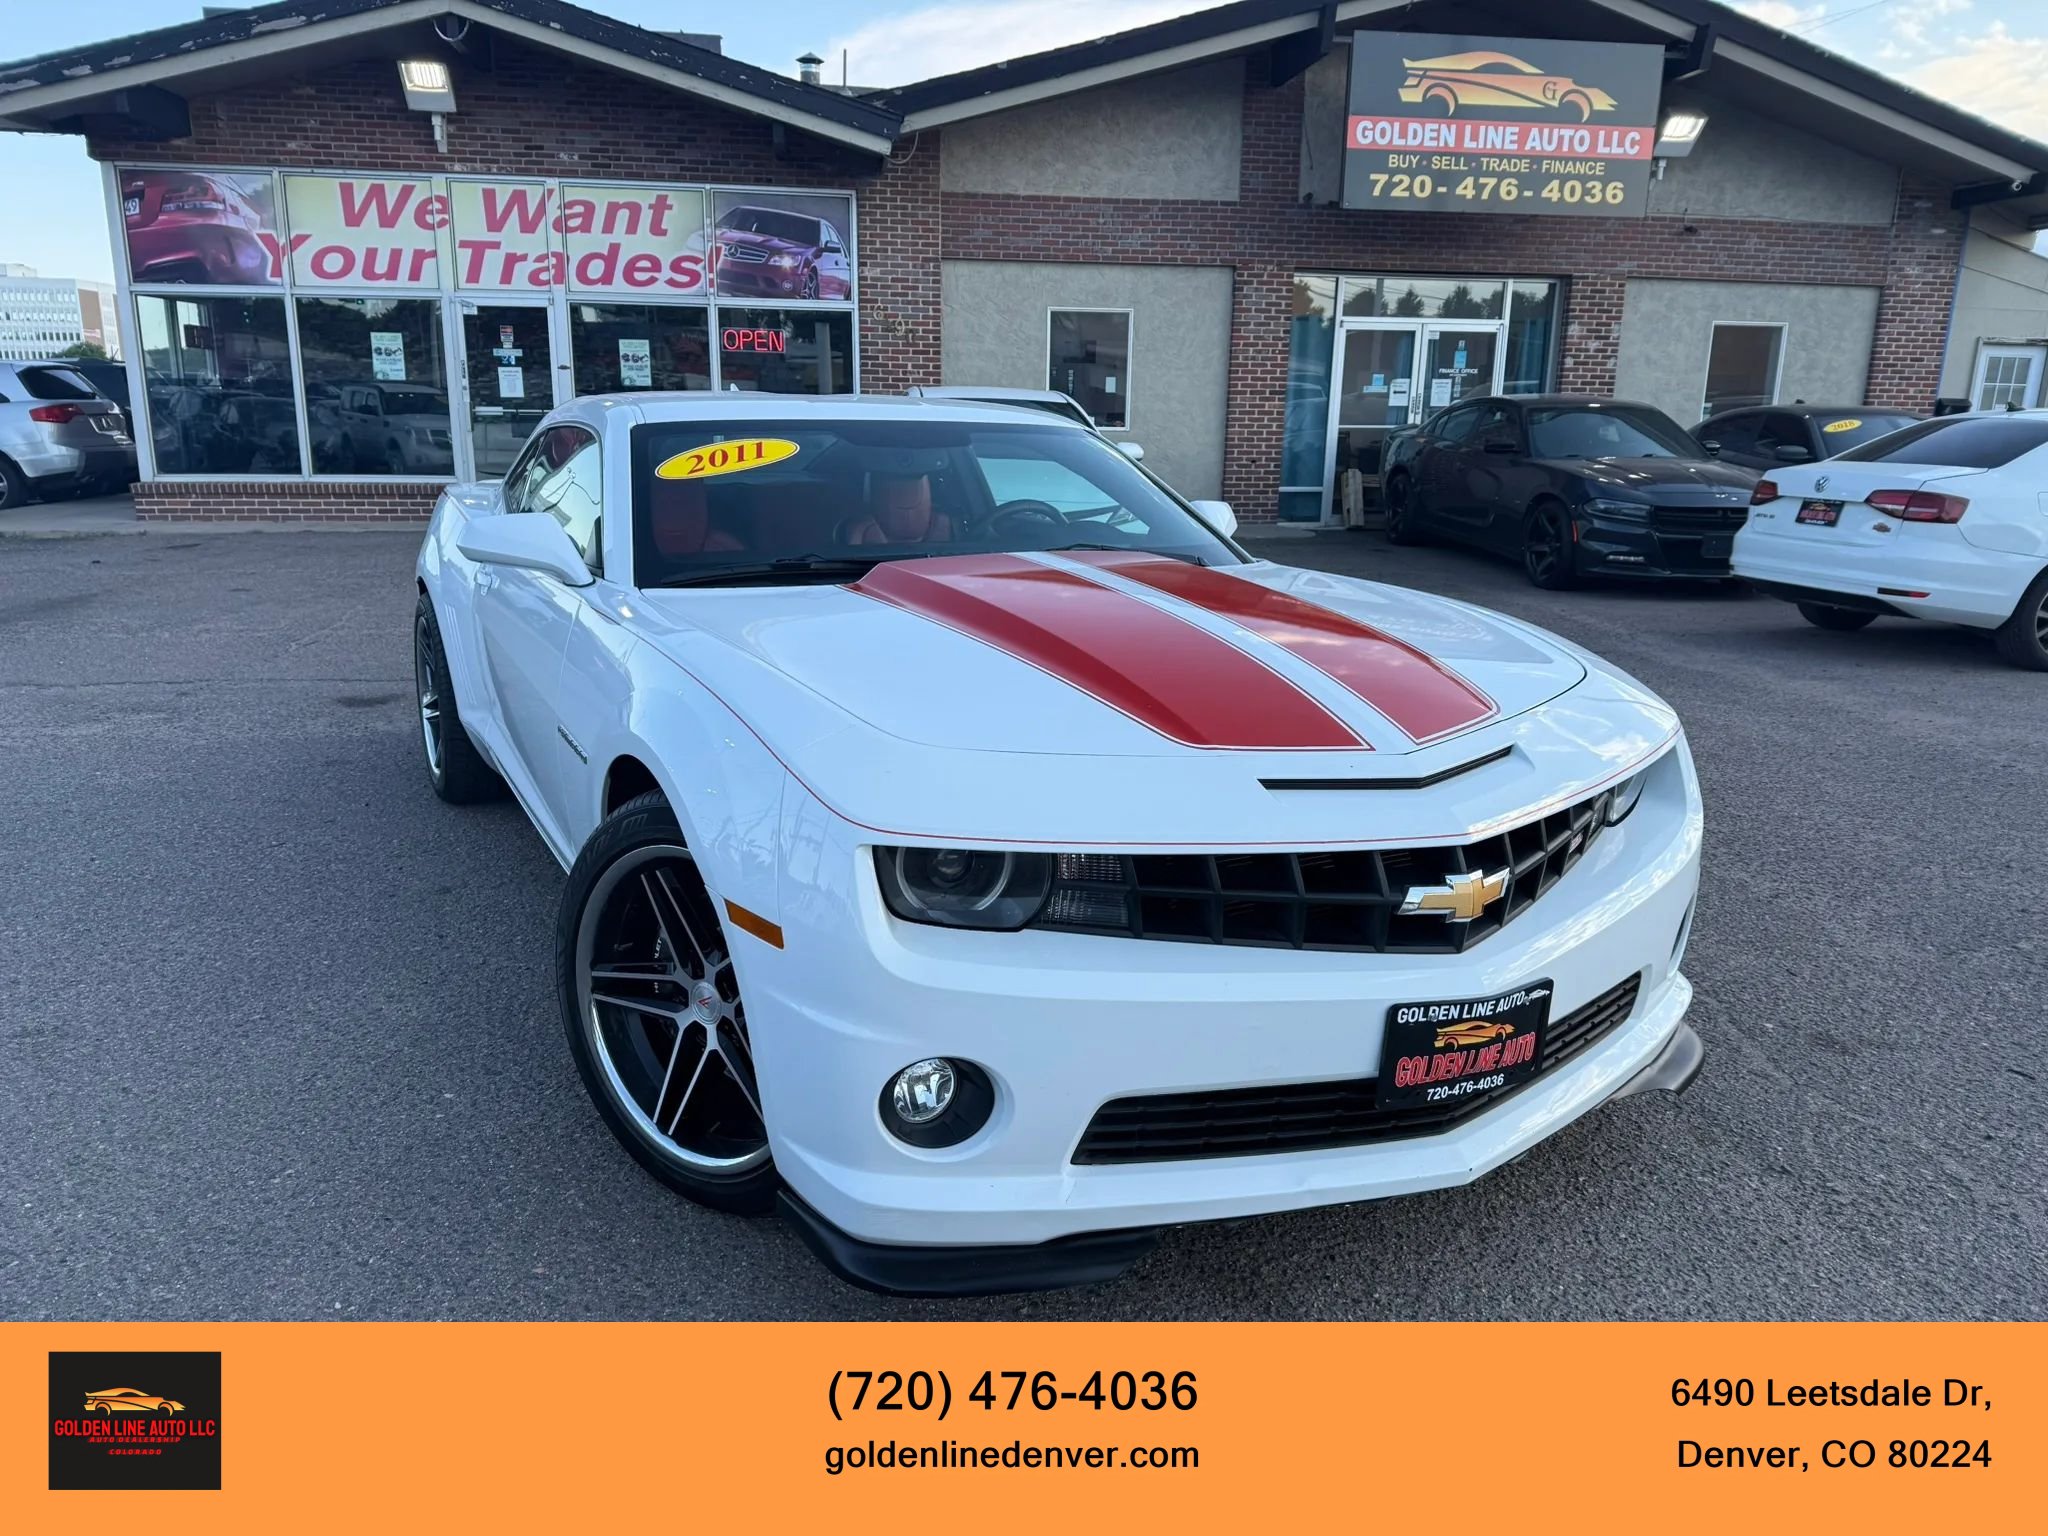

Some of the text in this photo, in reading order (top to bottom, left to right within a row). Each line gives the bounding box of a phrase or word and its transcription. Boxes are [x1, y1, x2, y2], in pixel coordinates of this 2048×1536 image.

[1356, 120, 1640, 155] GOLDEN LINE AUTO LLC
[1388, 155, 1605, 176] BUY SELL TRADE FINANCE
[339, 181, 673, 237] We Want
[256, 233, 724, 290] Your Trades!
[724, 329, 783, 351] OPEN
[686, 441, 768, 475] 2011
[1397, 991, 1525, 1024] GOLDEN LINE AUTO
[1395, 1032, 1536, 1087] GOLDEN LINE AUTO
[1426, 1073, 1504, 1101] 720-476-4036
